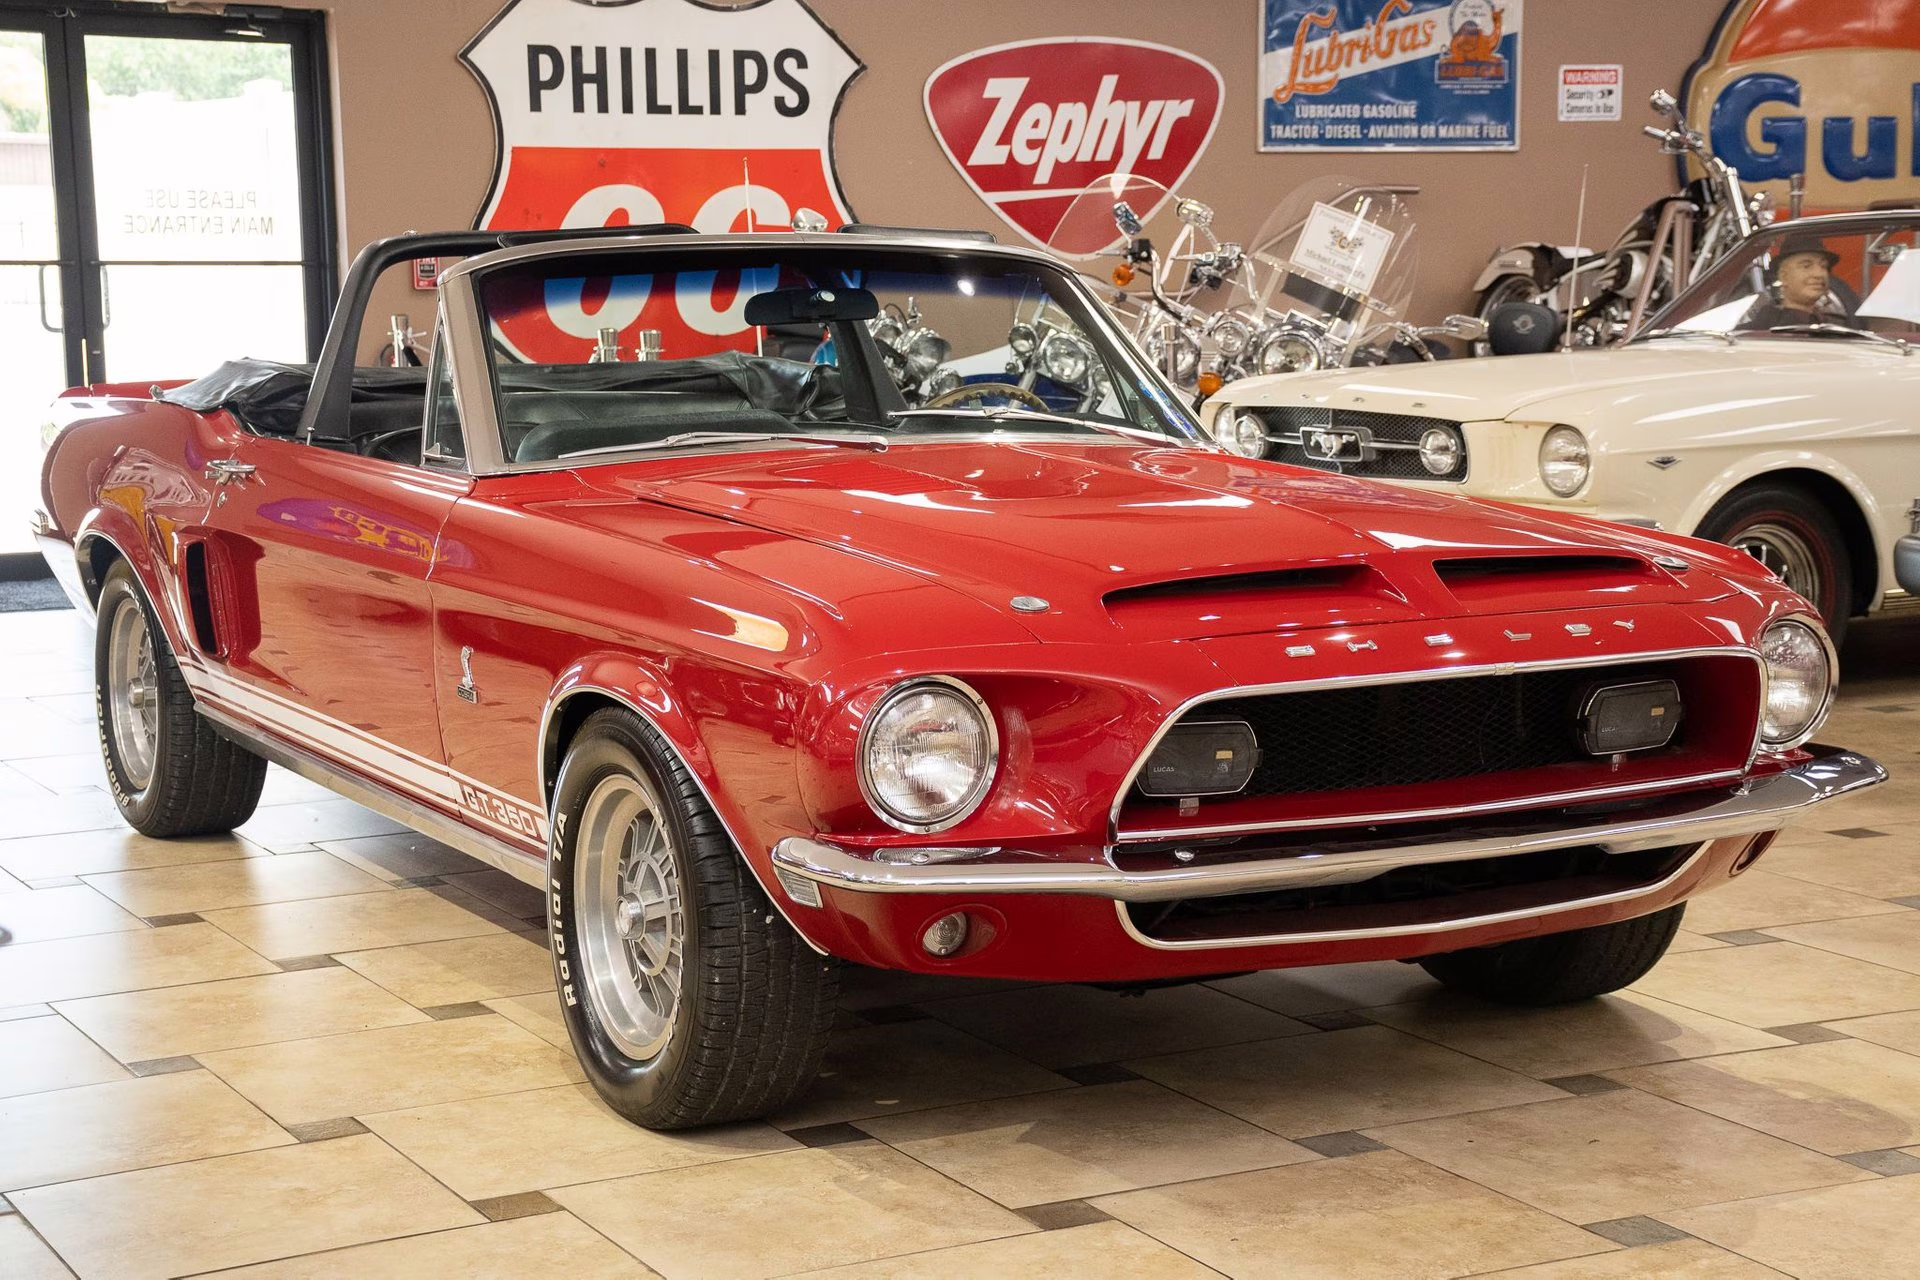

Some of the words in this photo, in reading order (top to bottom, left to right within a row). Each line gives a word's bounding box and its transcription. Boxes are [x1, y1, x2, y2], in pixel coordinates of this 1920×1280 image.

[527, 44, 810, 118] PHILLIPS
[1295, 104, 1361, 119] LUBRICATED
[1363, 104, 1417, 119] GASOLINE
[967, 74, 1195, 198] Zephyr
[1270, 124, 1319, 139] TRACTOR
[1324, 124, 1362, 139] DIESEL
[1368, 124, 1419, 139] AVIATION
[1438, 124, 1480, 138] MARINE
[1482, 124, 1508, 138] FUEL
[1710, 72, 1920, 183] Gu
[552, 811, 568, 862] T/A
[551, 877, 577, 1007] Radial
